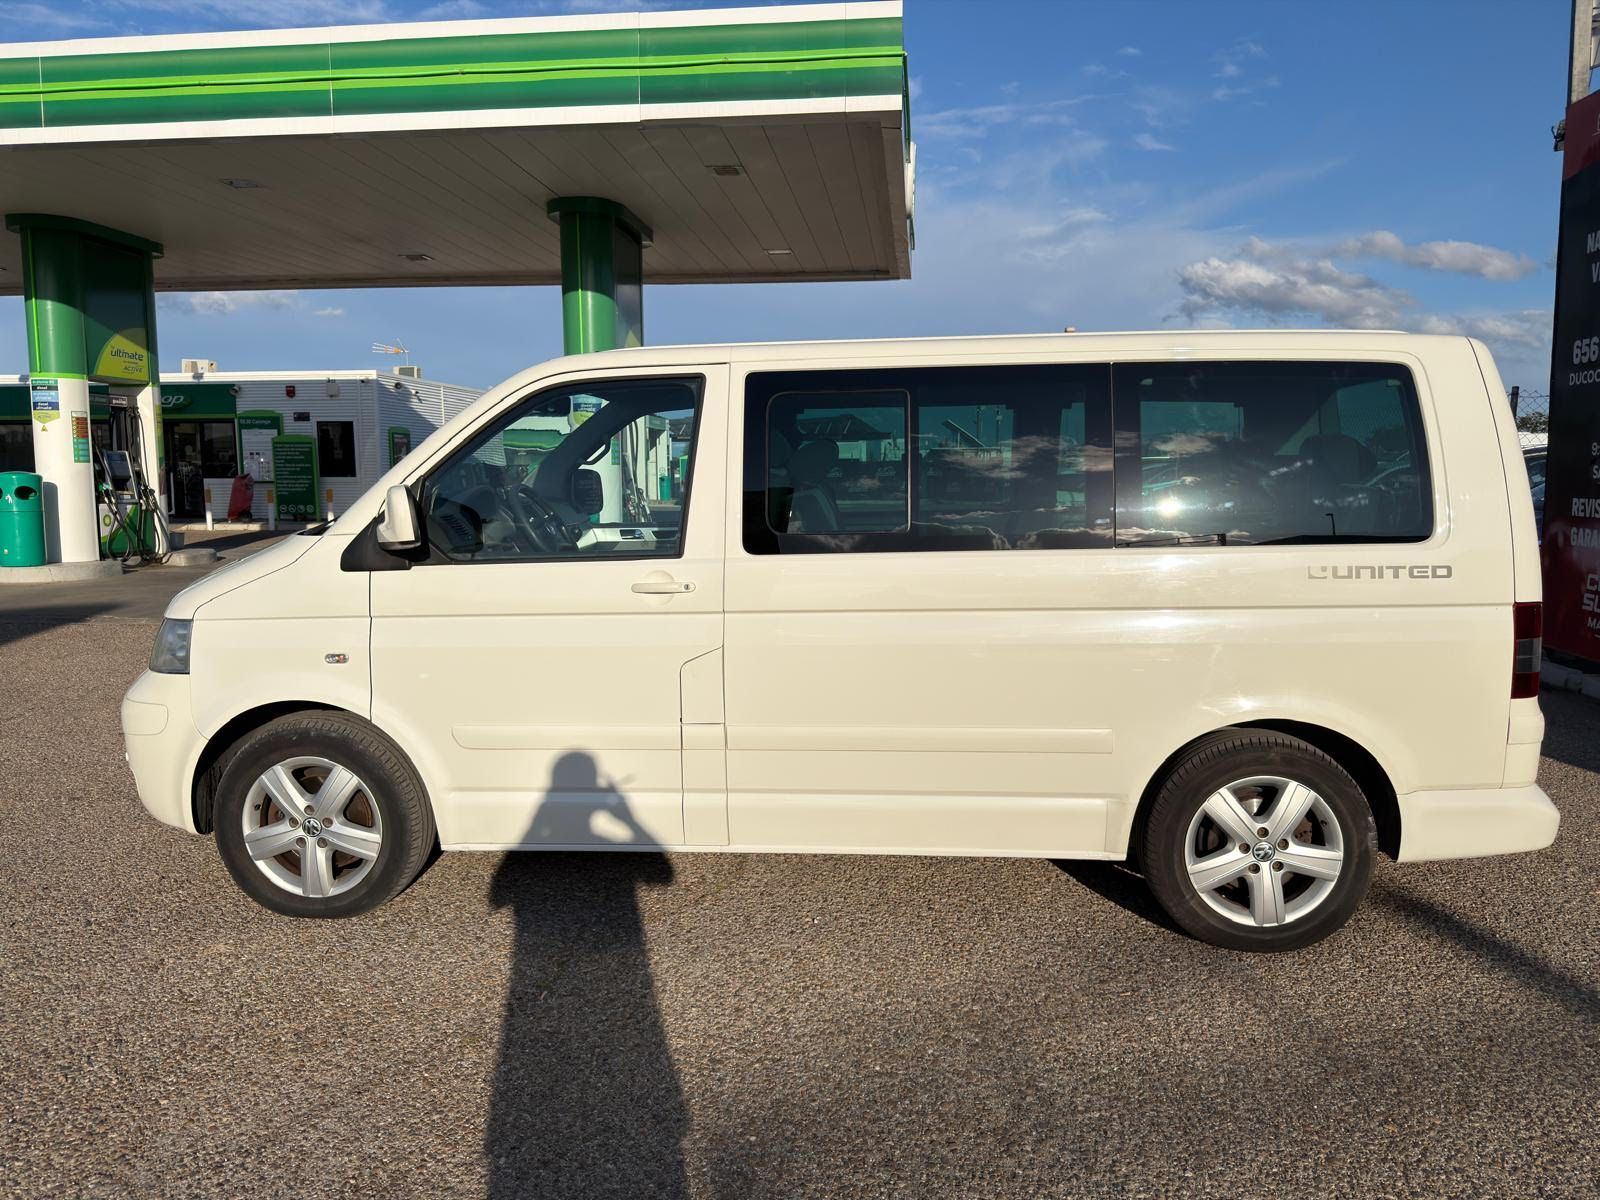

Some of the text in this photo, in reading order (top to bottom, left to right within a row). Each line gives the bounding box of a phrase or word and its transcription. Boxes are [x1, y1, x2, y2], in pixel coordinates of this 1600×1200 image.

[111, 349, 144, 361] ultimate
[1573, 336, 1599, 365] 656
[1331, 565, 1453, 579] UNITED
